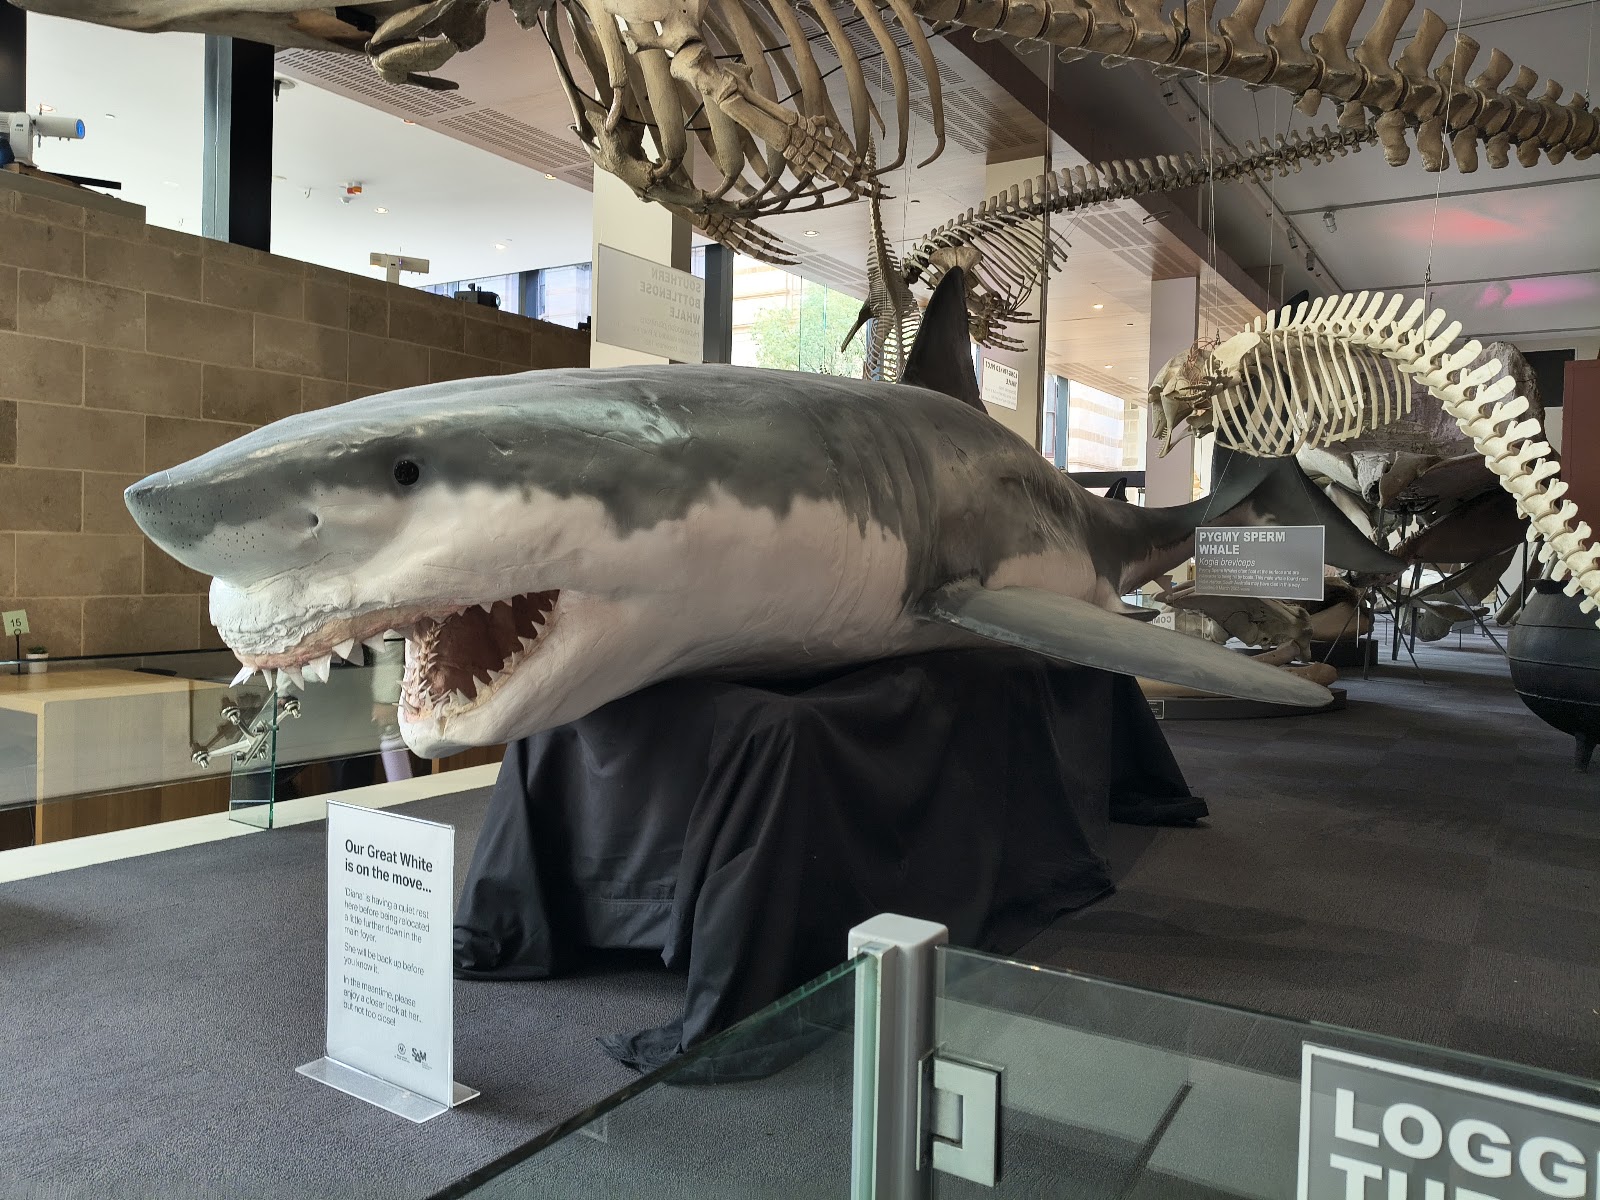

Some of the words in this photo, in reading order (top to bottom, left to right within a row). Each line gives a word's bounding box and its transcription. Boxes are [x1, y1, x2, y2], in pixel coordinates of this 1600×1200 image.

[1198, 544, 1240, 554] WHALE
[1199, 531, 1240, 542] PYGMY
[1243, 531, 1286, 542] SPERM
[1198, 558, 1218, 568] Kogia
[10, 618, 22, 627] 15
[345, 839, 364, 856] Our
[368, 844, 398, 864] Great
[400, 852, 433, 872] White
[345, 858, 354, 872] is
[356, 864, 370, 876] on
[372, 866, 390, 882] the
[392, 872, 432, 893] move...
[344, 900, 358, 912] here
[360, 904, 379, 918] before
[380, 910, 398, 925] being
[399, 918, 430, 932] relocated
[372, 894, 392, 910] having
[398, 903, 415, 916] quiet
[416, 908, 429, 919] rest
[344, 926, 358, 936] main
[350, 914, 362, 926] little
[363, 917, 384, 932] further
[386, 926, 403, 938] down
[403, 930, 410, 939] in
[411, 932, 422, 943] the
[344, 942, 356, 954] She
[357, 948, 366, 956] will
[368, 949, 376, 960] be
[377, 952, 392, 965] back
[393, 959, 402, 970] up
[403, 960, 424, 976] before
[344, 956, 355, 967] you
[356, 959, 373, 972] know
[344, 974, 350, 984] In
[350, 977, 360, 989] the
[362, 982, 394, 1001] meantime,
[394, 993, 416, 1008] please
[344, 988, 360, 1002] enjoy
[366, 996, 385, 1008] closer
[386, 1001, 400, 1015] look
[400, 1008, 407, 1018] at
[344, 1001, 353, 1011] but
[355, 1005, 364, 1016] not
[366, 1007, 376, 1019] too
[1335, 1087, 1600, 1198] LOGG
[1329, 1153, 1502, 1200] TU
